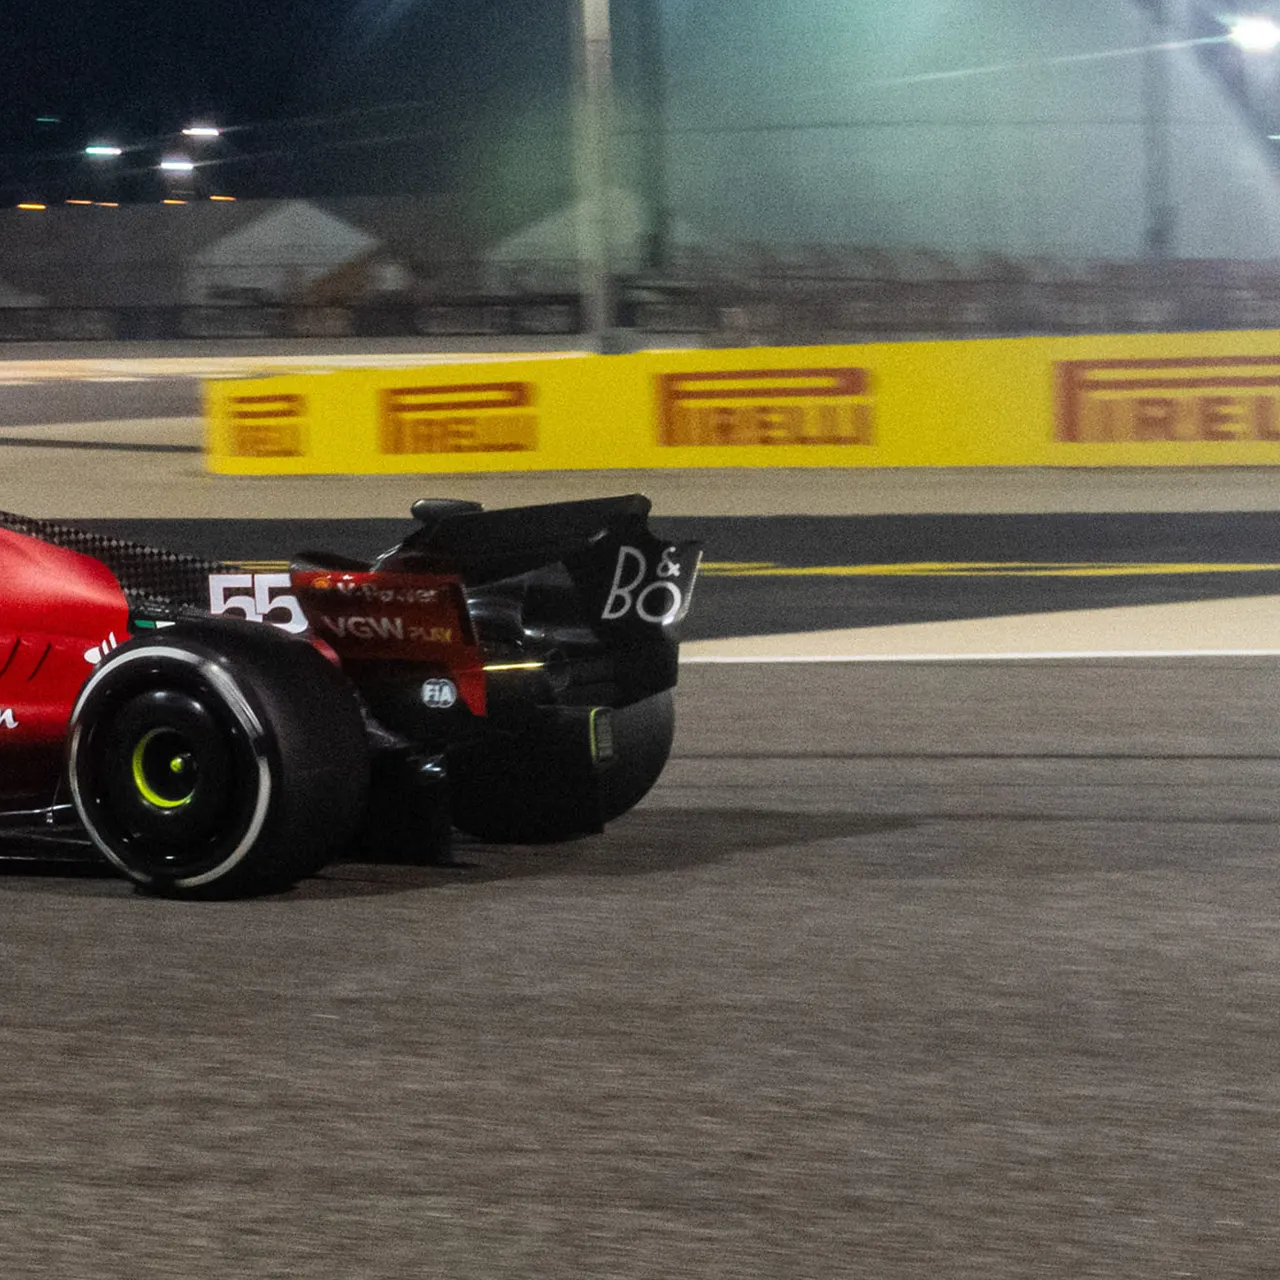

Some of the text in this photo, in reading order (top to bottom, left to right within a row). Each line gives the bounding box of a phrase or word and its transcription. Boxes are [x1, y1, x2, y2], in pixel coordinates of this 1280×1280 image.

[1052, 356, 1280, 442] PIREL
[208, 573, 309, 634] 55
[322, 616, 404, 640] VGW
